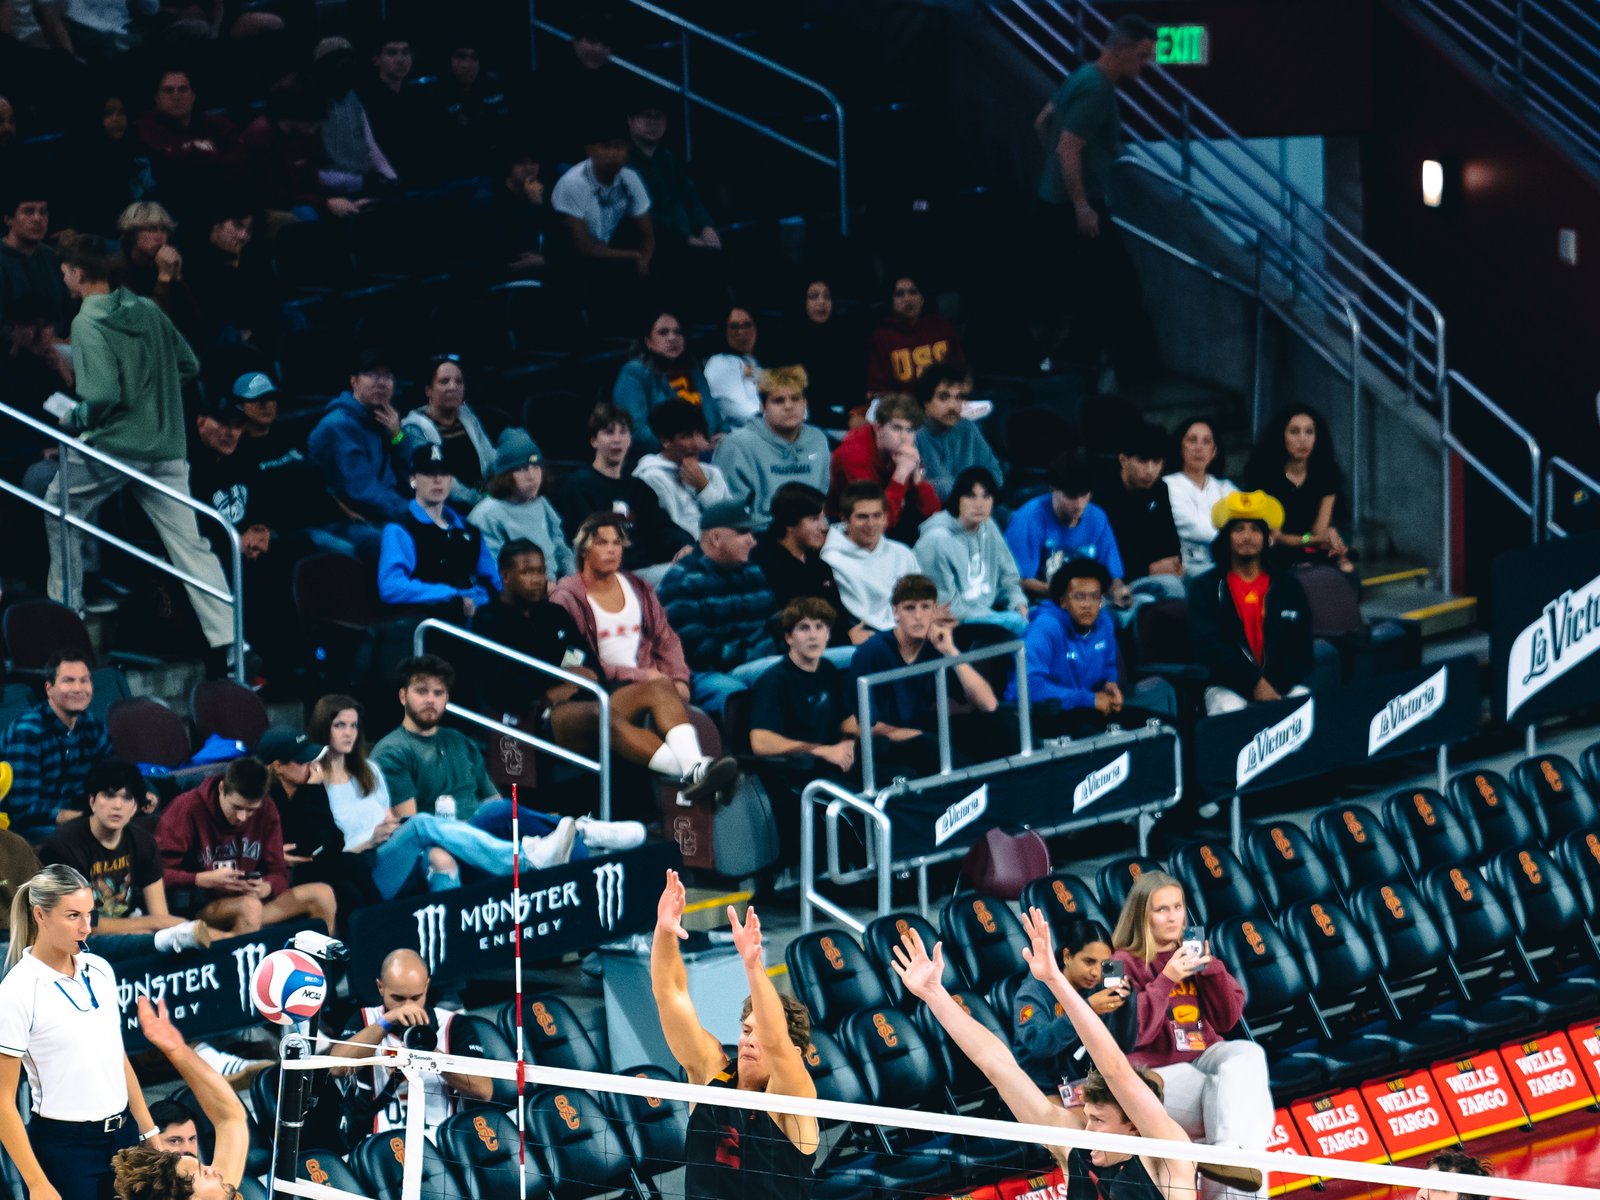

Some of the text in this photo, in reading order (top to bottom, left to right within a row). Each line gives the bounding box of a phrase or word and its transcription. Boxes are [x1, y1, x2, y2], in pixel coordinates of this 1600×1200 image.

[1156, 26, 1204, 64] EXIT
[1523, 627, 1549, 685] La
[1387, 685, 1436, 729] Victoria
[1253, 718, 1302, 762] Victoria
[1086, 765, 1120, 794] Victoria
[946, 798, 979, 823] Victoria
[479, 918, 563, 950] ENERGY
[117, 963, 220, 1013] ONSTER
[1516, 1046, 1567, 1075] WELLS
[1446, 1066, 1499, 1095] WELLS
[1527, 1069, 1577, 1098] FARGO
[1376, 1085, 1430, 1114] WELLS
[1457, 1088, 1509, 1117] FARGO
[1307, 1104, 1360, 1134] WELLS
[1388, 1107, 1440, 1136] FARGO
[1318, 1127, 1370, 1156] FARGO
